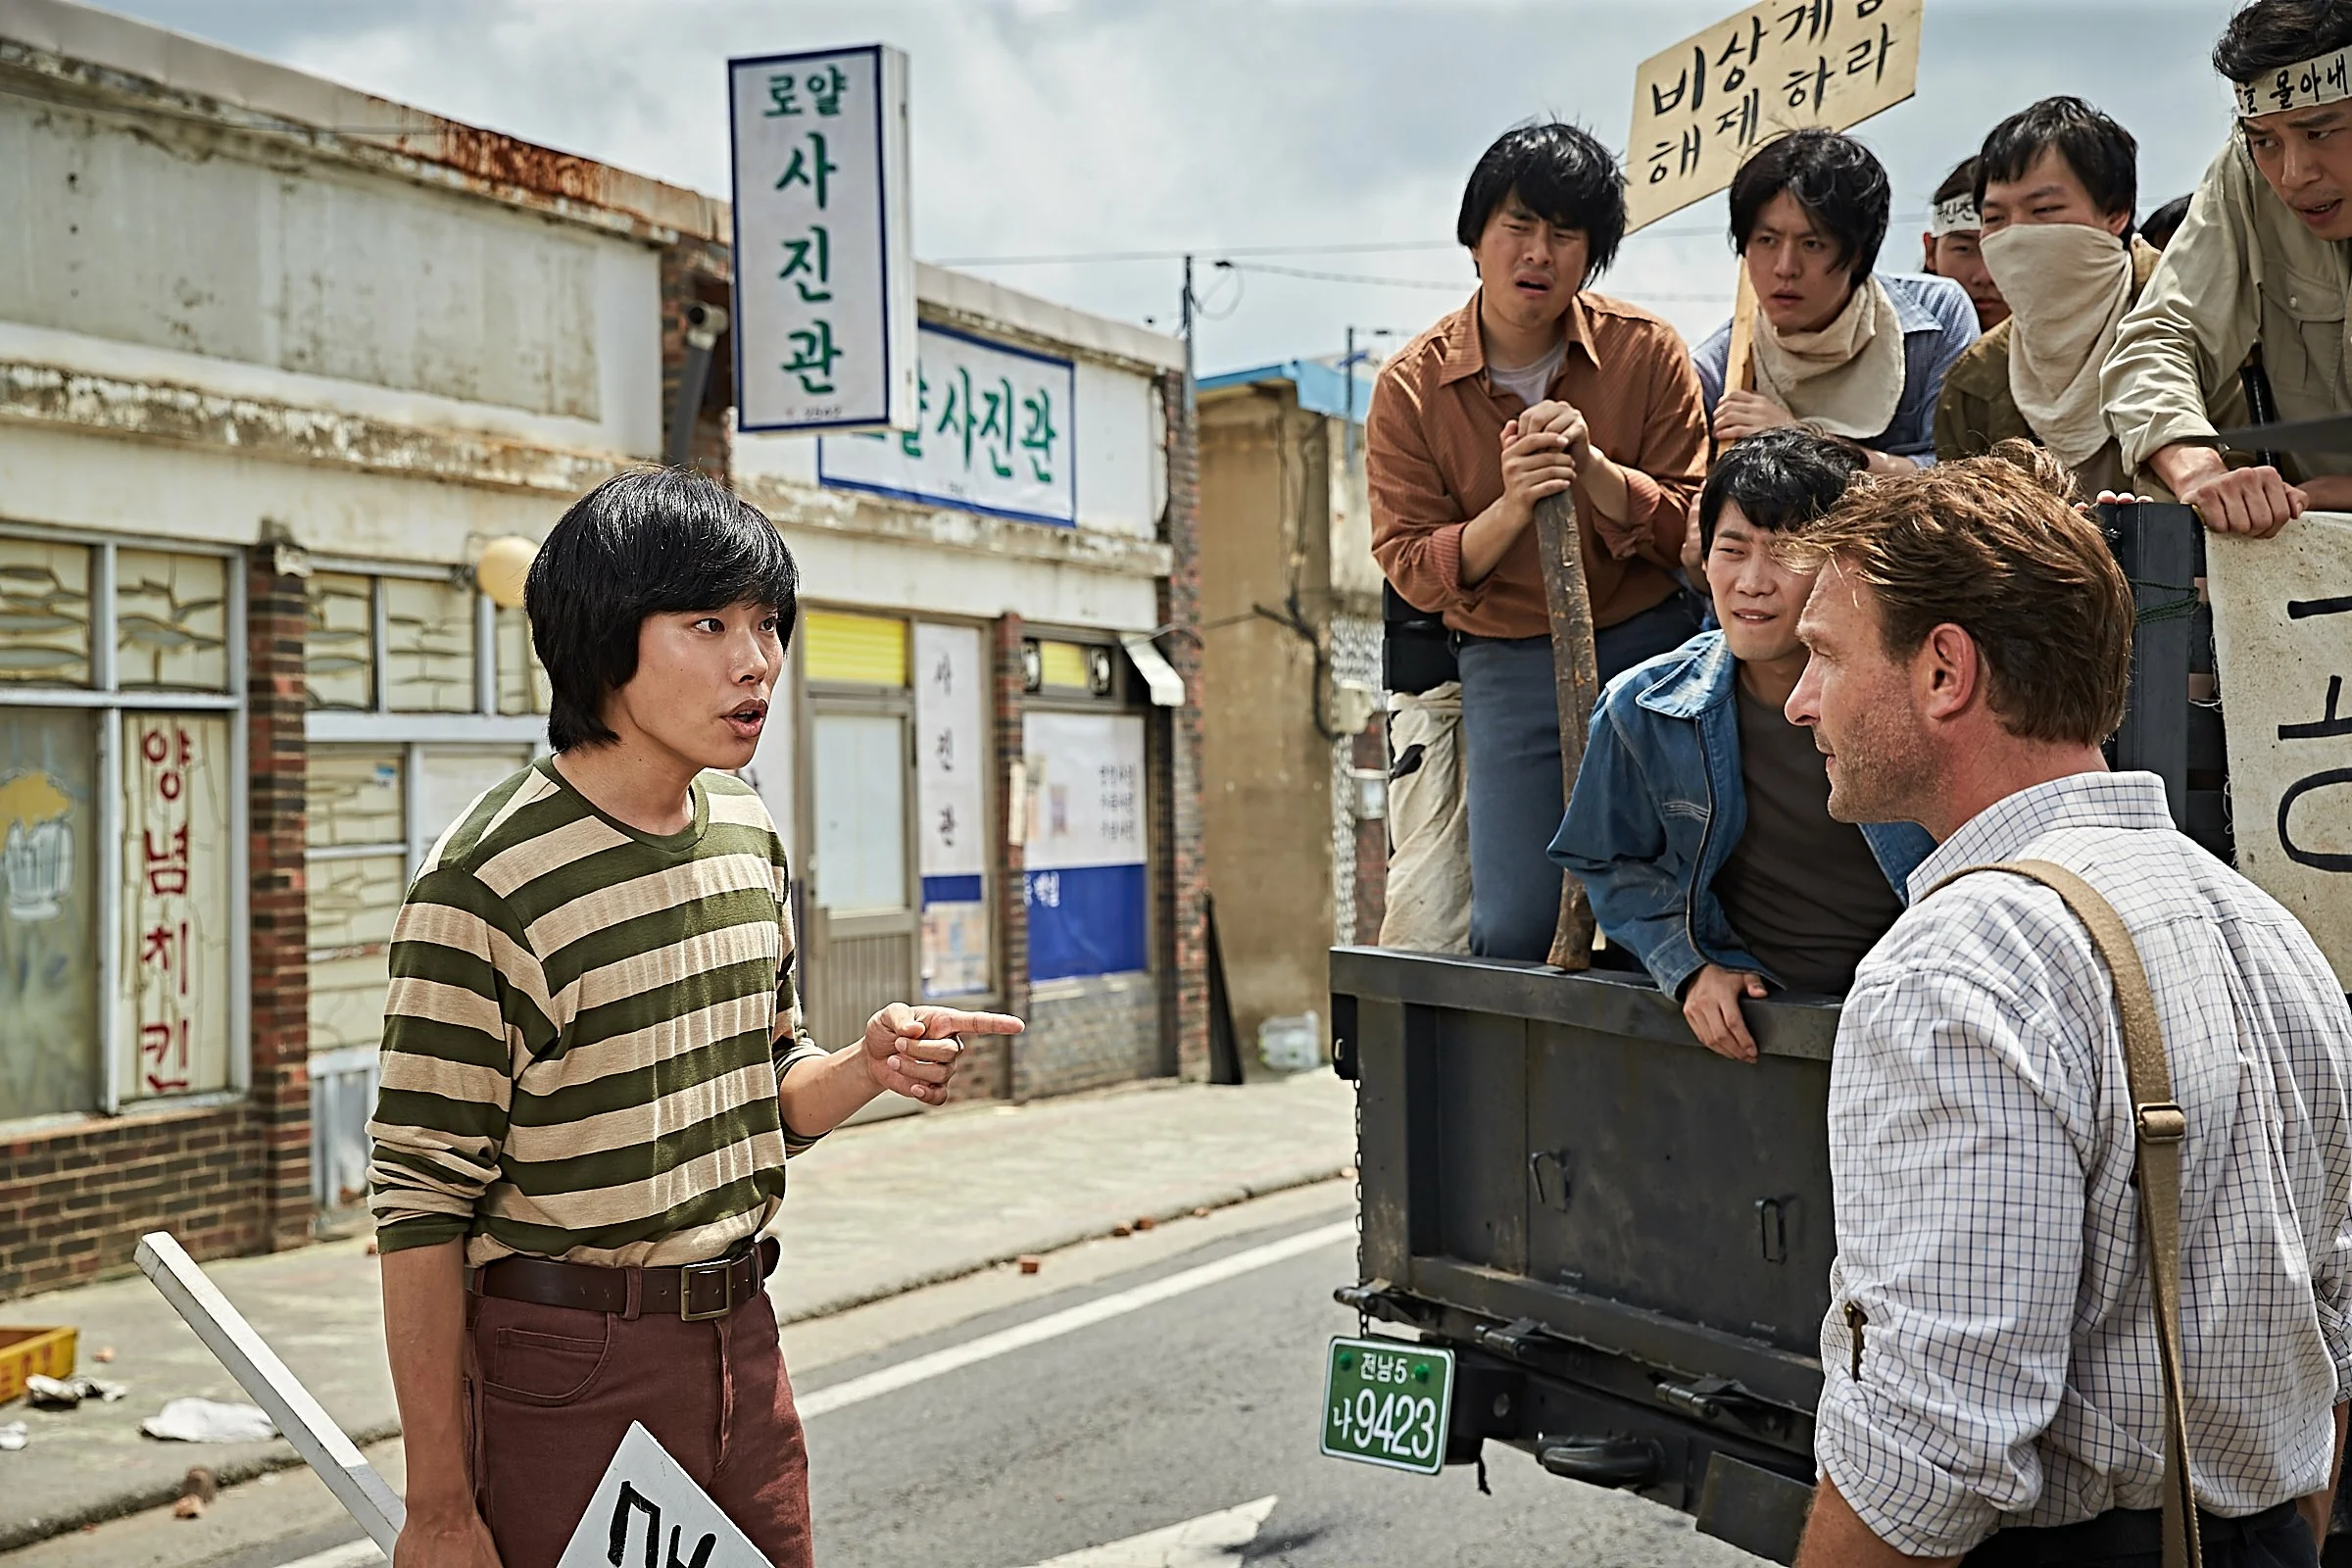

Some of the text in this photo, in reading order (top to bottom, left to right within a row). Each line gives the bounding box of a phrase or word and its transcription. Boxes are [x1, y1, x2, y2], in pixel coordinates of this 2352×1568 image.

[763, 65, 848, 117] 로얄
[1648, 23, 1898, 184] 해제하라
[2270, 53, 2349, 110] 몰아내
[775, 132, 844, 395] 사진관
[851, 361, 1057, 483] 사진관
[142, 729, 191, 1095] 양념치킨
[1360, 1352, 1407, 1384] 전남5
